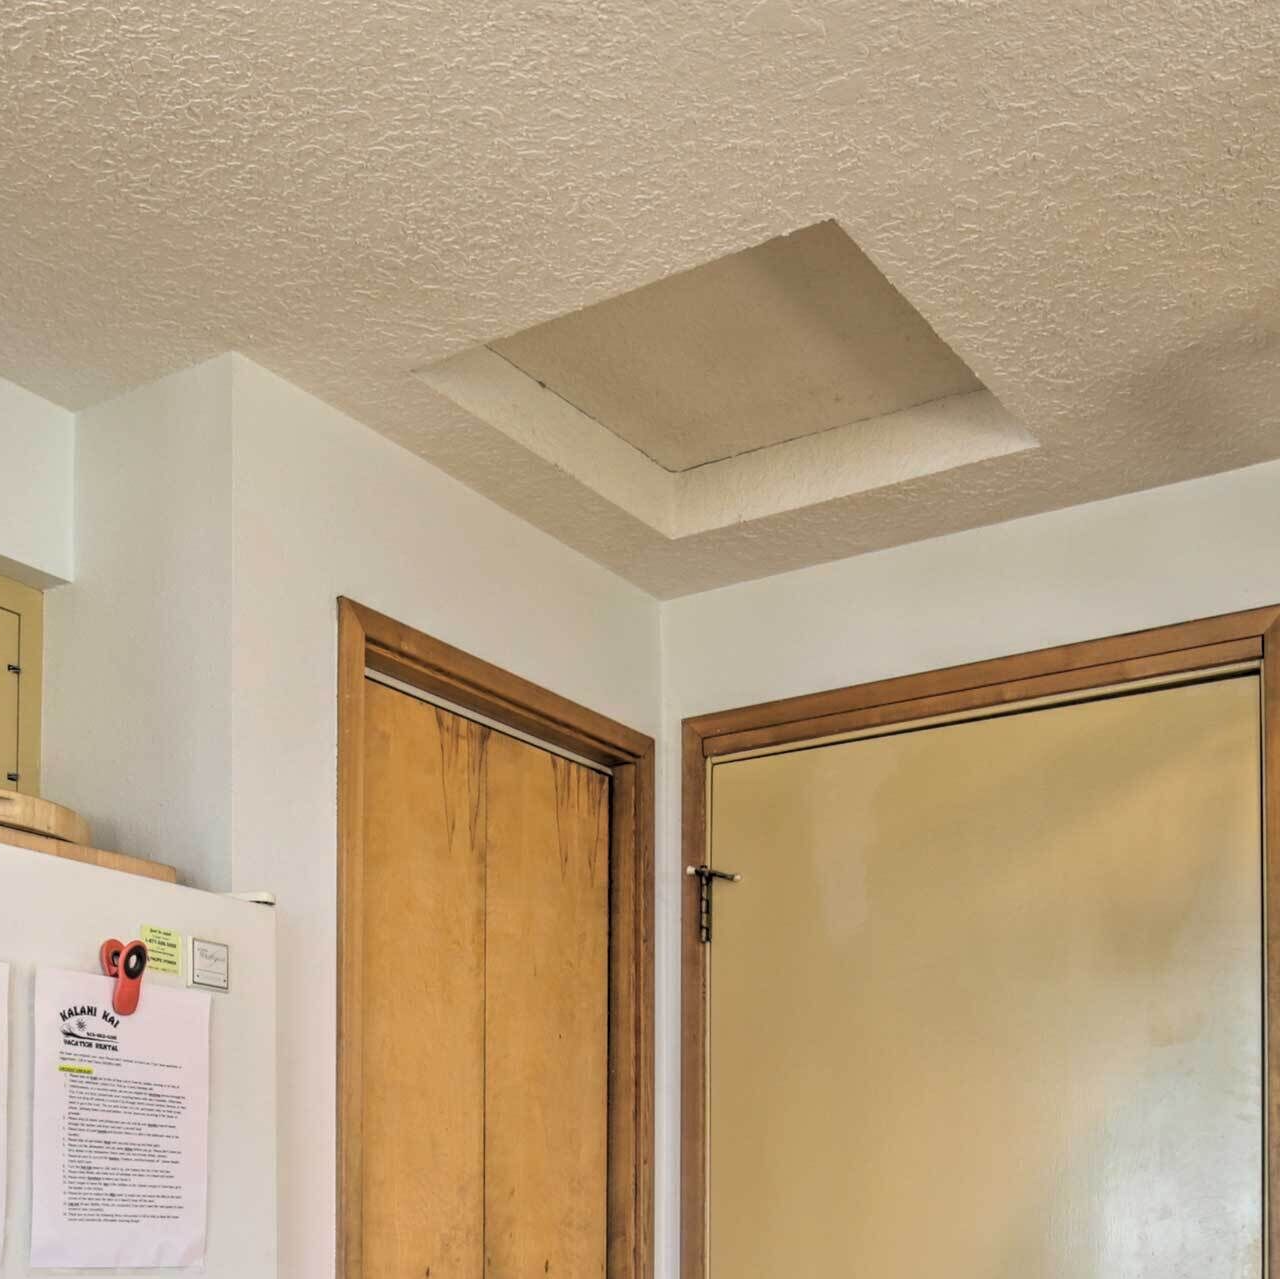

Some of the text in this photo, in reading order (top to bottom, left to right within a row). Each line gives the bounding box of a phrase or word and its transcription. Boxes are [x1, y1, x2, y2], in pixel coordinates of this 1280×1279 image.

[60, 1005, 120, 1028] KALANI KAI
[63, 1039, 119, 1052] VACATION RENTAL
